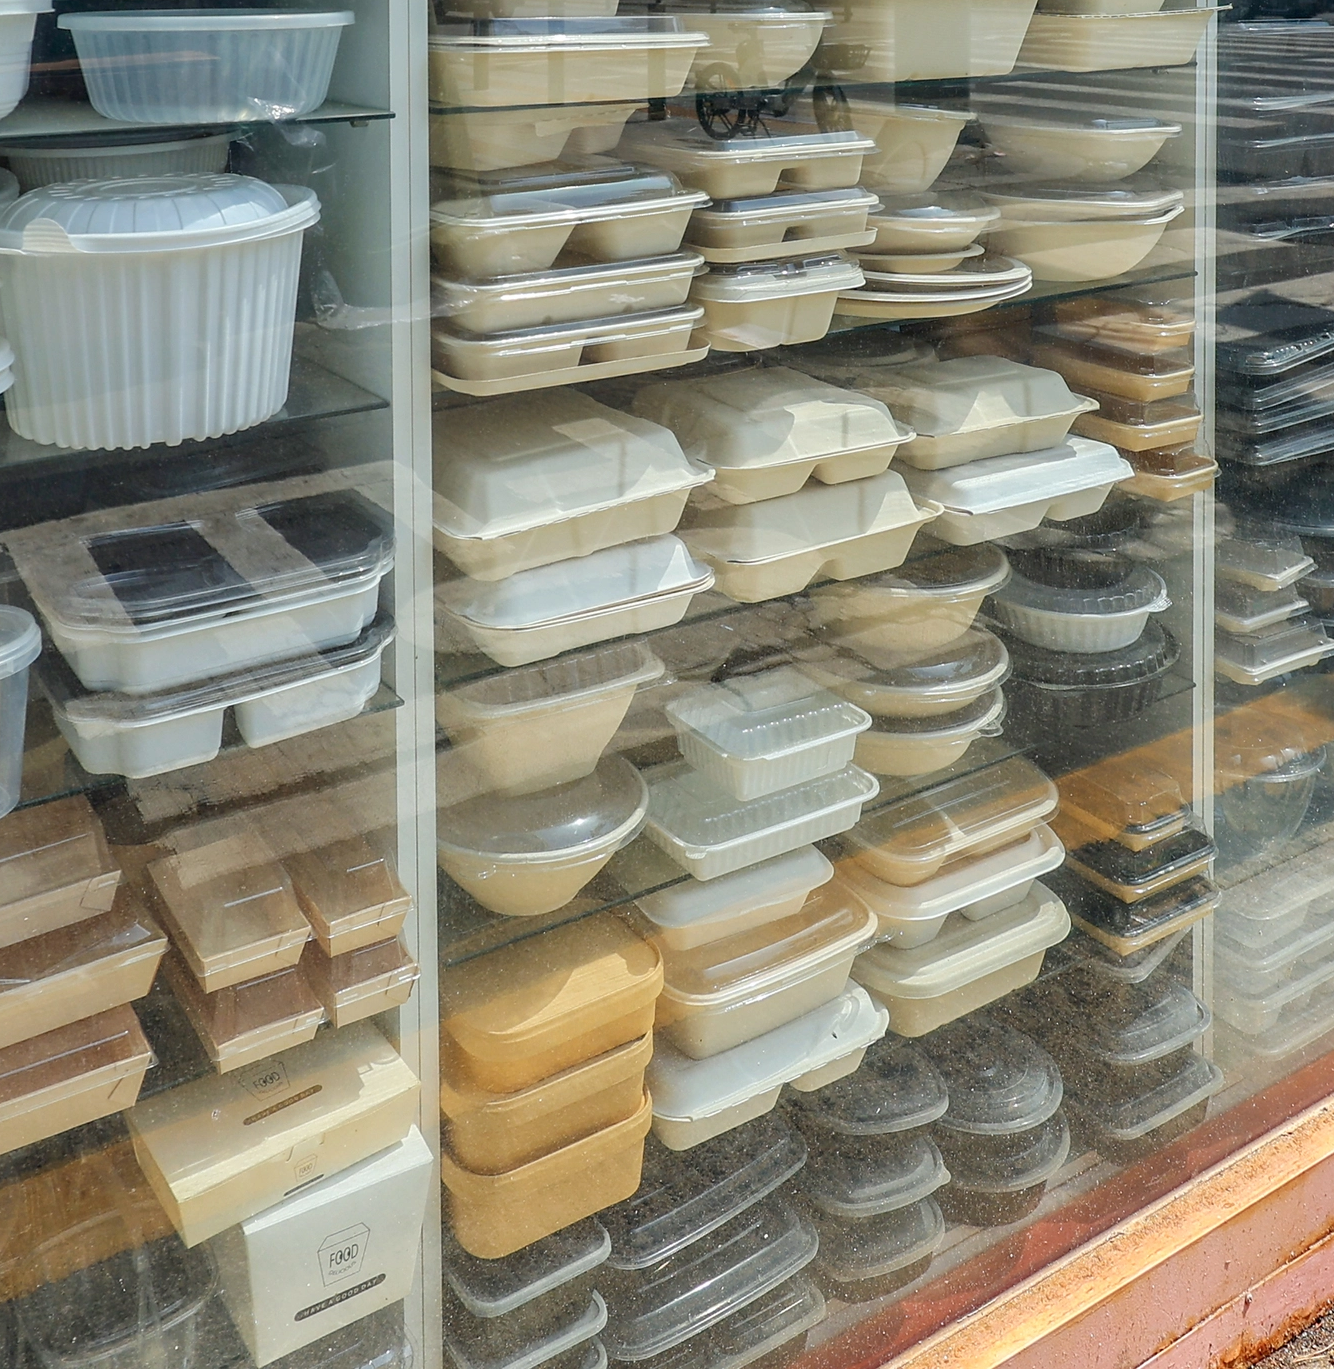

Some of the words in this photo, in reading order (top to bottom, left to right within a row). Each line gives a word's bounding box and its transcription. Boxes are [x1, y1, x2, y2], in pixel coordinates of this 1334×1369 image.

[252, 1071, 282, 1090] FOOD
[328, 1242, 360, 1269] FOOD
[303, 1301, 327, 1318] HAVE
[334, 1285, 360, 1303] GOOD
[360, 1276, 379, 1291] DAY
